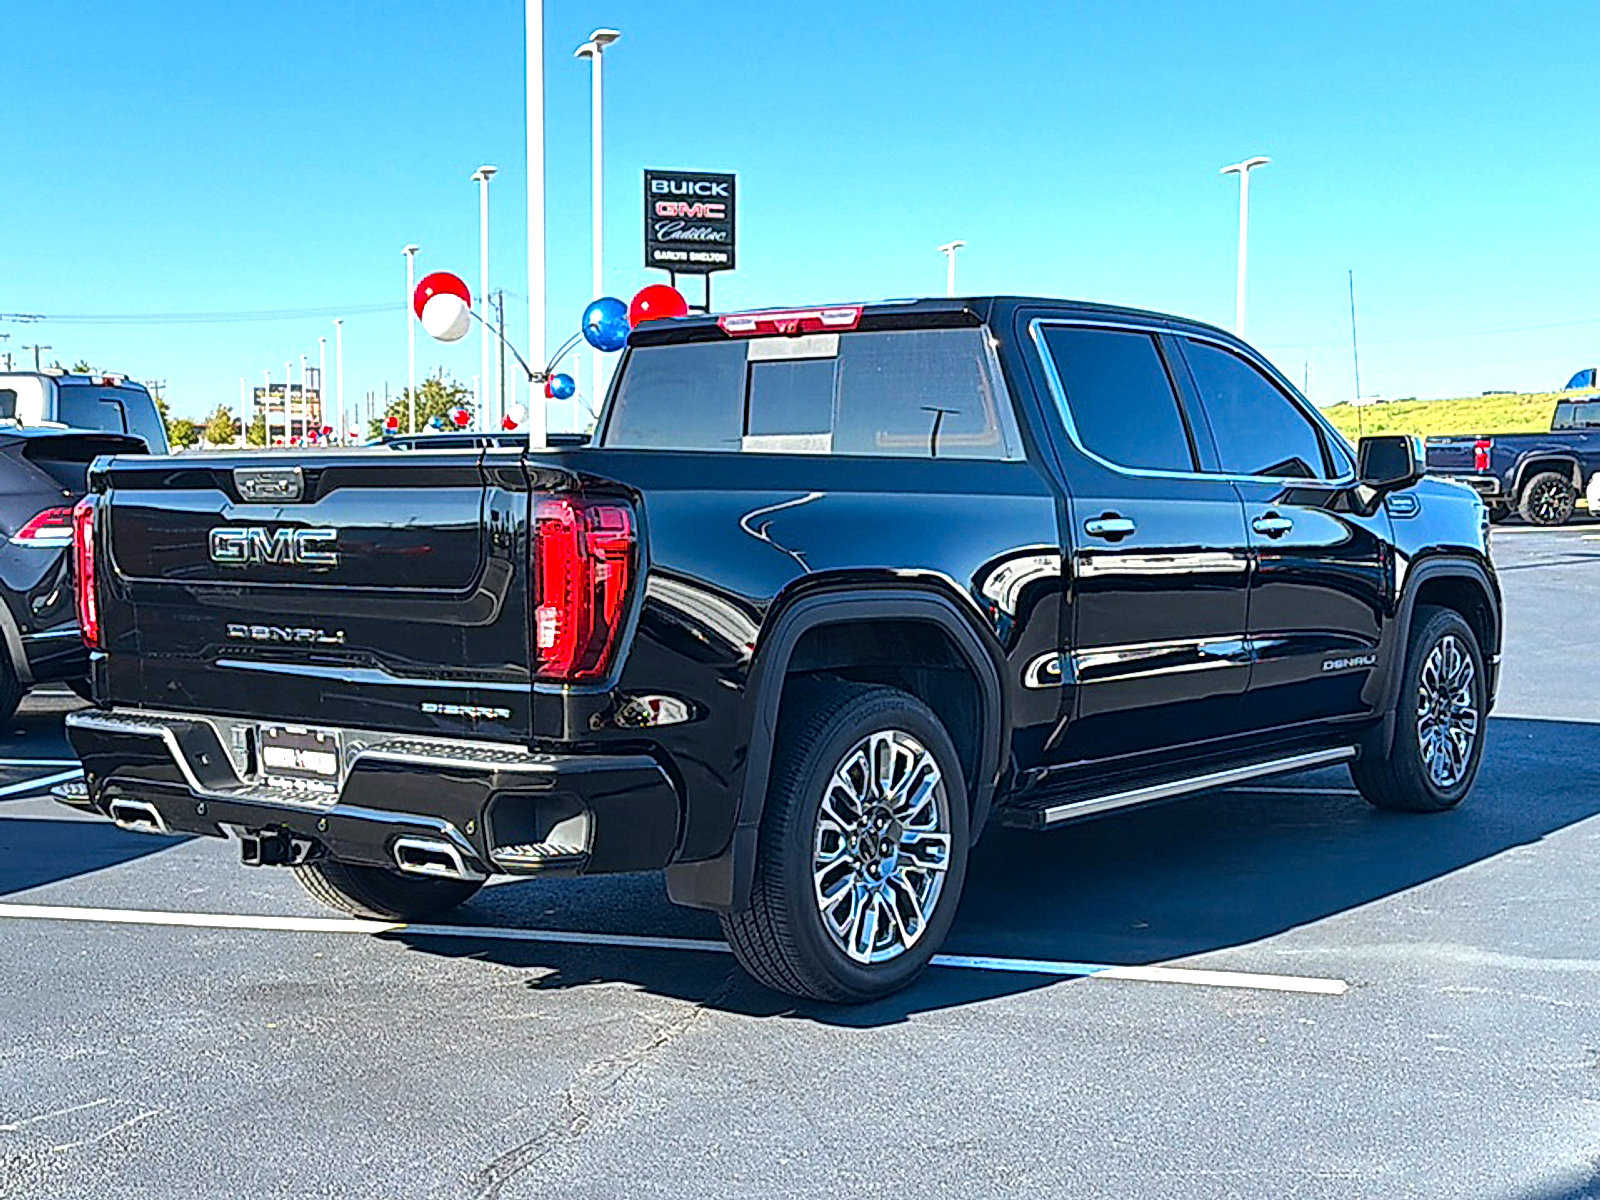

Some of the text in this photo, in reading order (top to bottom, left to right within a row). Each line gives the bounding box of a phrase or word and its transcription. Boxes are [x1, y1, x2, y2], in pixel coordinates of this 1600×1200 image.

[651, 179, 729, 197] BUICK
[655, 201, 725, 219] GMC
[654, 220, 727, 241] Cadillac
[209, 527, 340, 566] GMC
[226, 623, 346, 645] DENALI
[1322, 654, 1377, 671] DENALI
